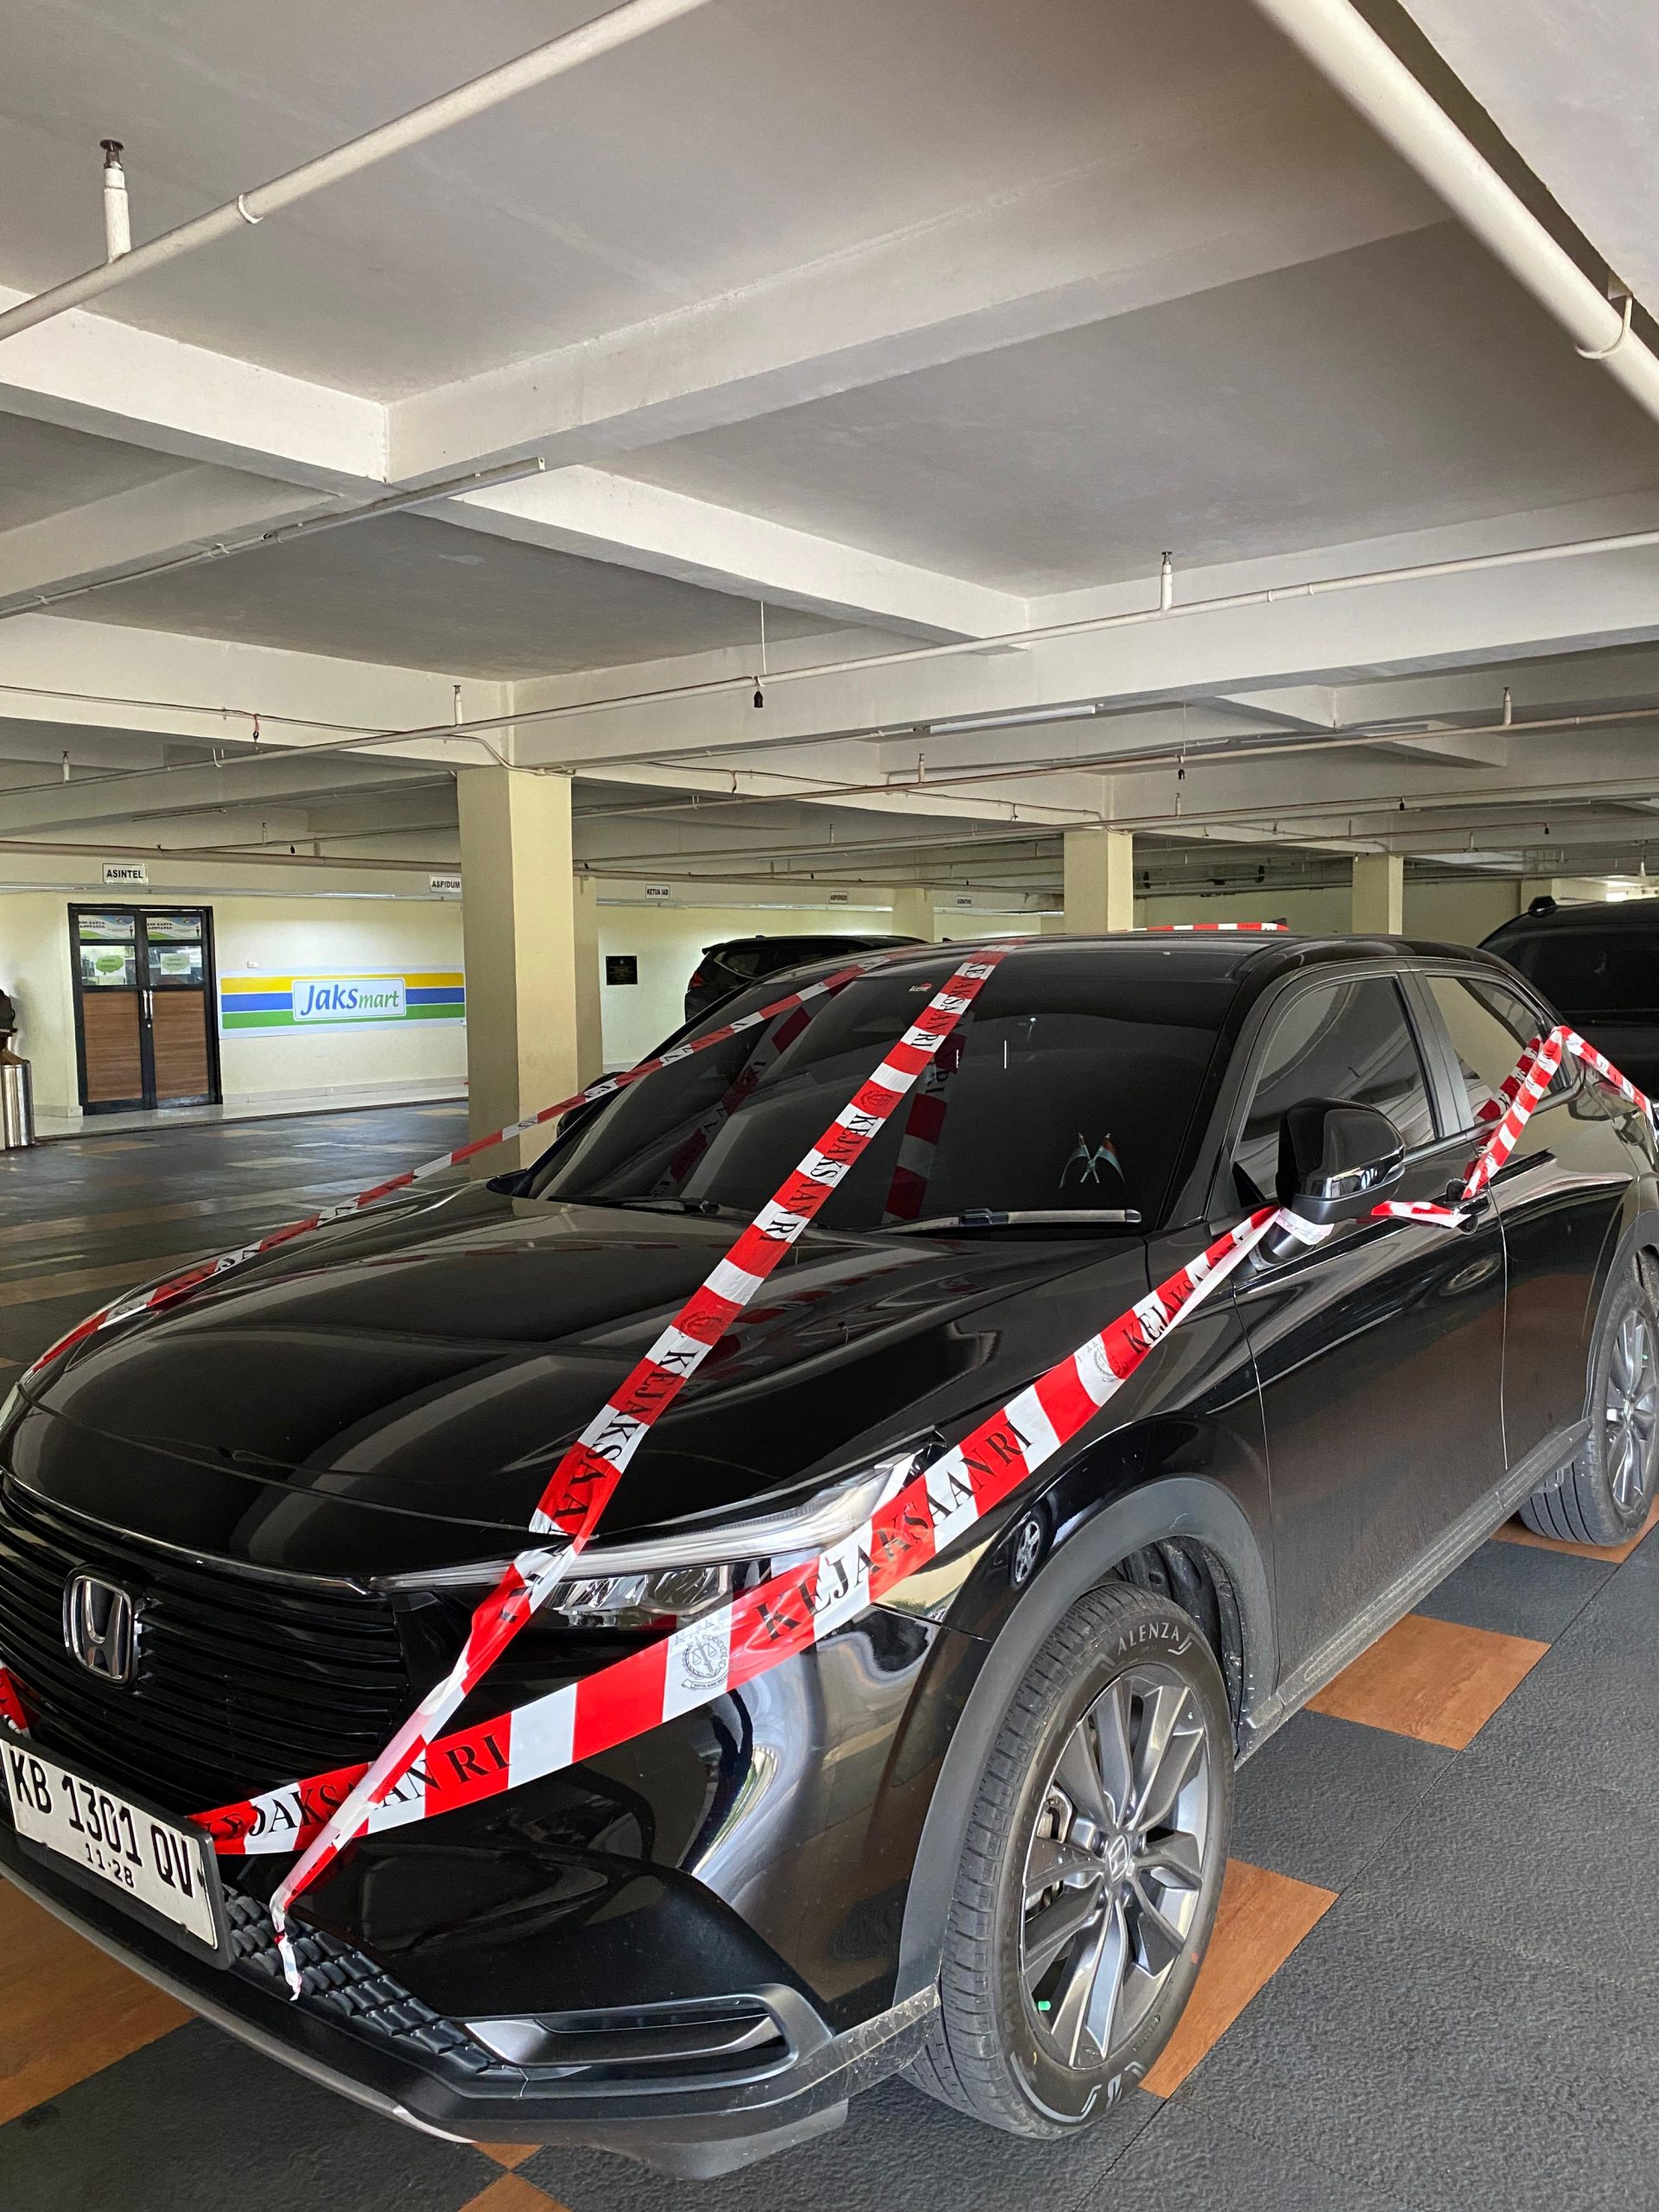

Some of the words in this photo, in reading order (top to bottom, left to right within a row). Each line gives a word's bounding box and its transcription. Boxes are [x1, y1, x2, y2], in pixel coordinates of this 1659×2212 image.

[106, 869, 143, 879] ASINTEL
[431, 880, 461, 889] ASPIDUM
[911, 1033, 939, 1047] RI
[783, 1113, 880, 1219] KEJAKSAAN
[760, 1220, 799, 1243] RI
[753, 1448, 995, 1643] KEJAKSAAN
[1117, 1622, 1180, 1656] ALENZA
[443, 1735, 512, 1783] RI
[10, 1749, 52, 1814] KB
[61, 1776, 143, 1867] 1301
[150, 1825, 194, 1898] QV
